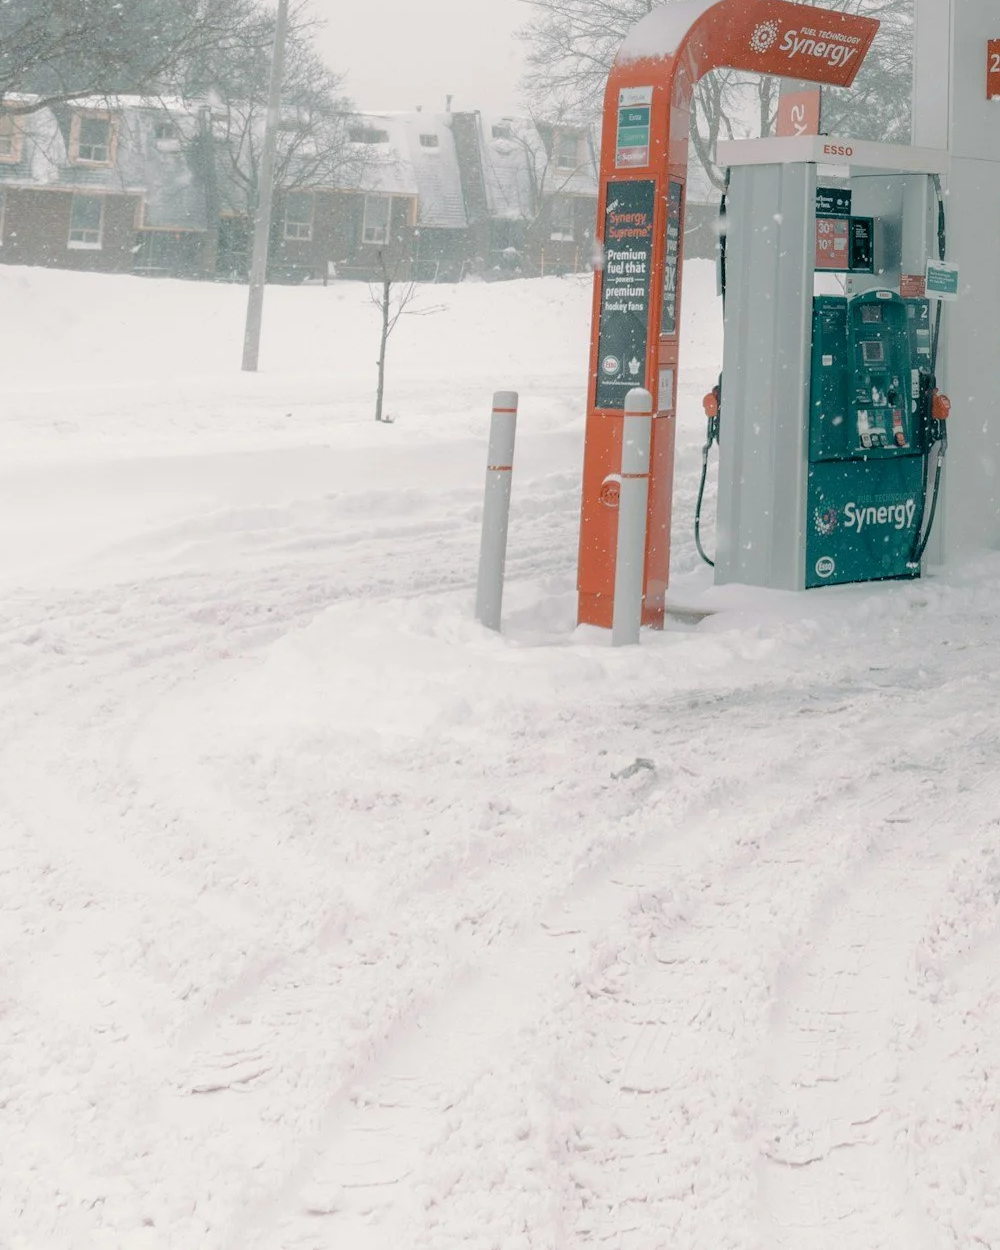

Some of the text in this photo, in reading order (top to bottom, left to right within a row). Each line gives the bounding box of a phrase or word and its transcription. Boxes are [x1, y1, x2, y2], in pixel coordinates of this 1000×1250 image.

[800, 27, 861, 45] FUEL TECHNOLOGY
[779, 30, 857, 67] Synergy
[990, 54, 1000, 72] 2
[823, 144, 853, 157] ESSO
[609, 212, 647, 226] Synergy
[607, 248, 647, 261] Premium
[607, 262, 646, 274] fuel that
[615, 276, 634, 284] powers
[605, 284, 645, 299] premium
[605, 301, 644, 313] hockey fans
[921, 305, 928, 318] 2
[844, 501, 916, 533] Synergy
